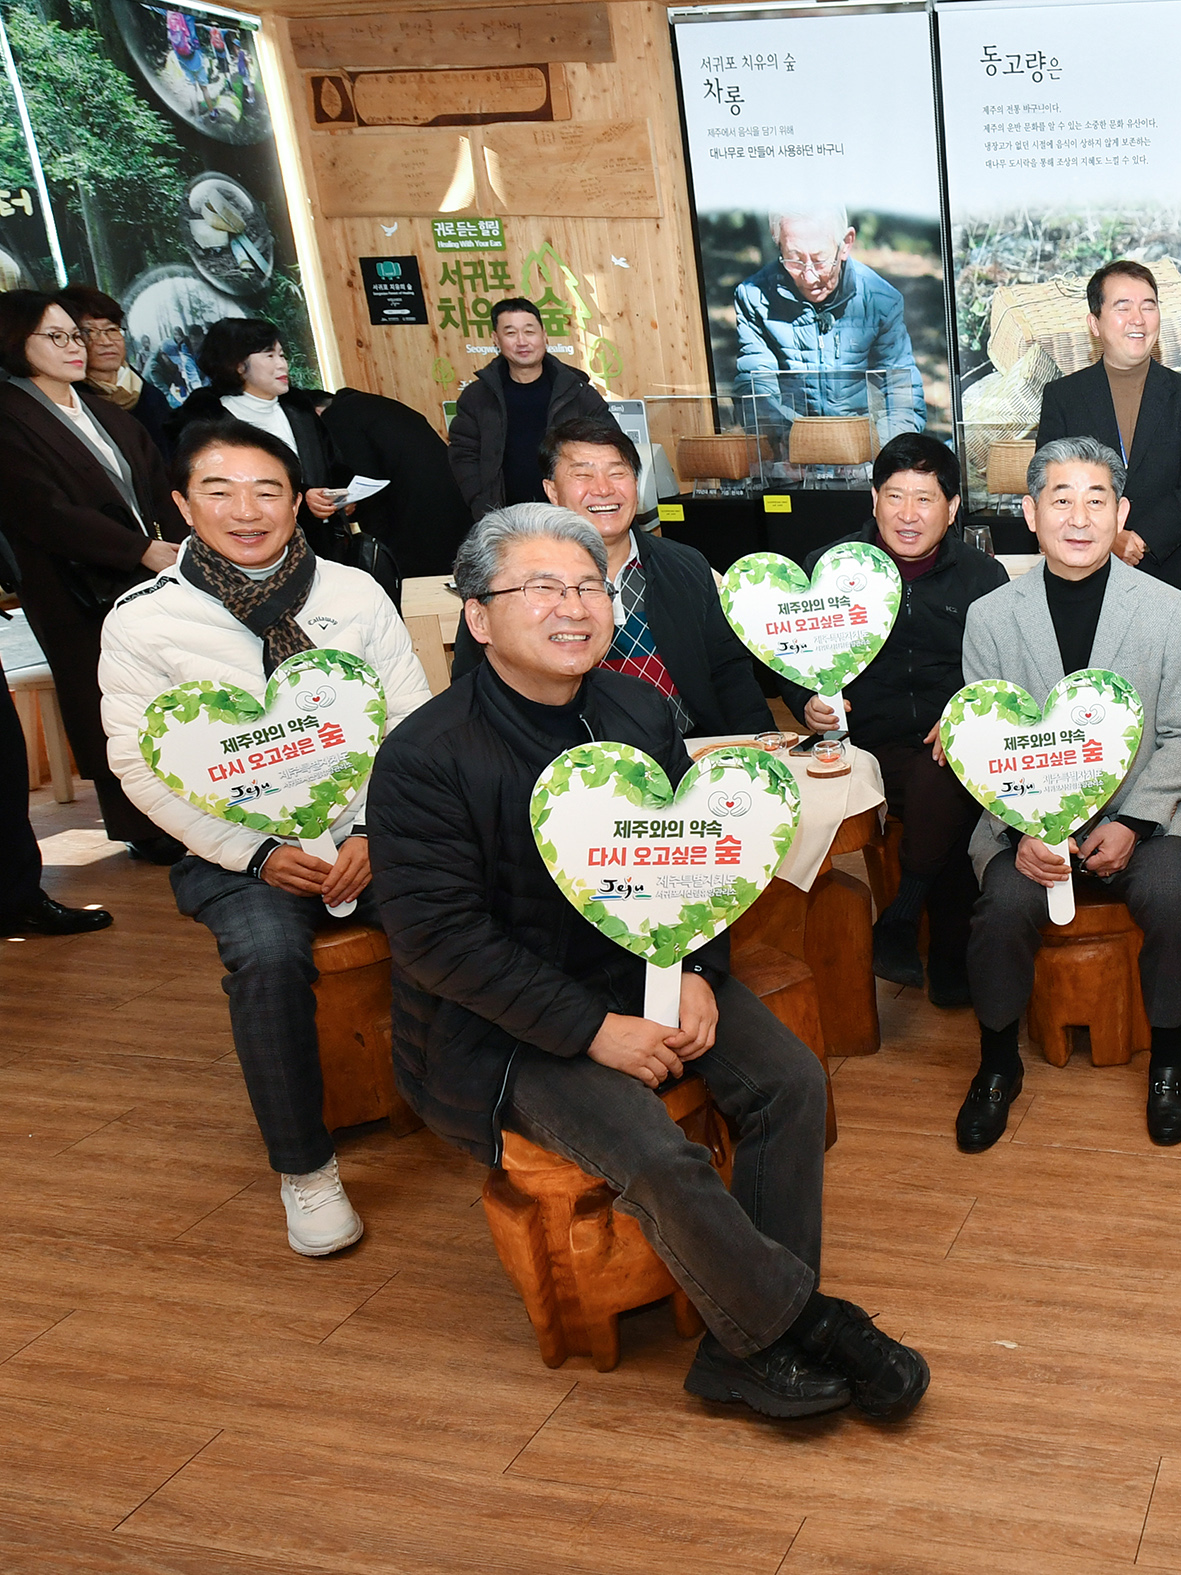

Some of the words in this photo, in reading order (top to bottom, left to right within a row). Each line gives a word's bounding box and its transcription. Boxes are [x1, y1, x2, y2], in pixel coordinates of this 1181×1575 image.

[700, 56, 737, 72] 서귀포
[742, 53, 778, 71] 치유의
[783, 53, 796, 72] 숲
[980, 45, 1063, 83] 동고량은
[703, 78, 745, 116] 차롱
[982, 105, 1004, 115] 제주의
[1007, 104, 1021, 115] 전통
[708, 128, 736, 138] 제주에서
[738, 126, 760, 137] 음식을
[762, 126, 777, 136] 담기
[779, 125, 794, 135] 위해
[983, 123, 1004, 133] 제주의
[1024, 122, 1046, 132] 문화를
[1048, 121, 1055, 131] 알
[1058, 121, 1065, 130] 수
[1068, 121, 1082, 131] 있는
[1085, 120, 1106, 130] 소중한
[1109, 119, 1123, 129] 문화
[710, 147, 745, 159] 대나무로
[748, 146, 775, 158] 만들어
[778, 144, 814, 157] 사용하던
[817, 143, 844, 156] 바구니
[984, 141, 1012, 151] 냉장고가
[1032, 139, 1053, 149] 시절에
[1056, 139, 1077, 149] 음식이
[1080, 138, 1101, 148] 상하지
[1122, 137, 1151, 147] 보존하는
[985, 159, 1006, 169] 대나무
[1009, 158, 1037, 168] 도시락을
[1040, 158, 1054, 167] 통해
[1057, 157, 1078, 166] 조상의
[1081, 157, 1103, 166] 지혜도
[1105, 156, 1119, 165] 느낄
[1122, 156, 1129, 165] 수
[434, 222, 457, 237] 귀로
[456, 222, 478, 237] 듣는
[478, 221, 500, 236] 힐링
[437, 241, 460, 249] Healing
[439, 259, 515, 293] 서귀포
[535, 287, 573, 337] 숲
[778, 599, 825, 615] 제주와의
[828, 595, 851, 609] 약속
[308, 616, 338, 625] Callaway
[766, 621, 792, 635] 다시
[795, 614, 845, 632] 오고싶은
[848, 604, 868, 625] 숲
[779, 641, 807, 654] Jeju
[220, 723, 286, 755] 제주와의
[288, 715, 321, 734] 약속
[1004, 732, 1056, 751] 제주와의
[1060, 729, 1085, 744] 약속
[207, 758, 245, 783] 다시
[248, 737, 316, 772] 오고싶은
[317, 721, 347, 750] 숲
[988, 758, 1017, 774] 다시
[1022, 749, 1077, 771] 오고싶은
[1082, 739, 1103, 763] 숲
[230, 781, 271, 798] Jeju
[1001, 781, 1034, 795] Jeju
[613, 820, 684, 839] 제주와의
[690, 820, 723, 838] 약속
[588, 847, 627, 867] 다시
[633, 846, 707, 866] 오고싶은
[714, 835, 742, 865] 숲
[599, 878, 644, 899] Jeju
[656, 874, 737, 887] 제주특별자치도
